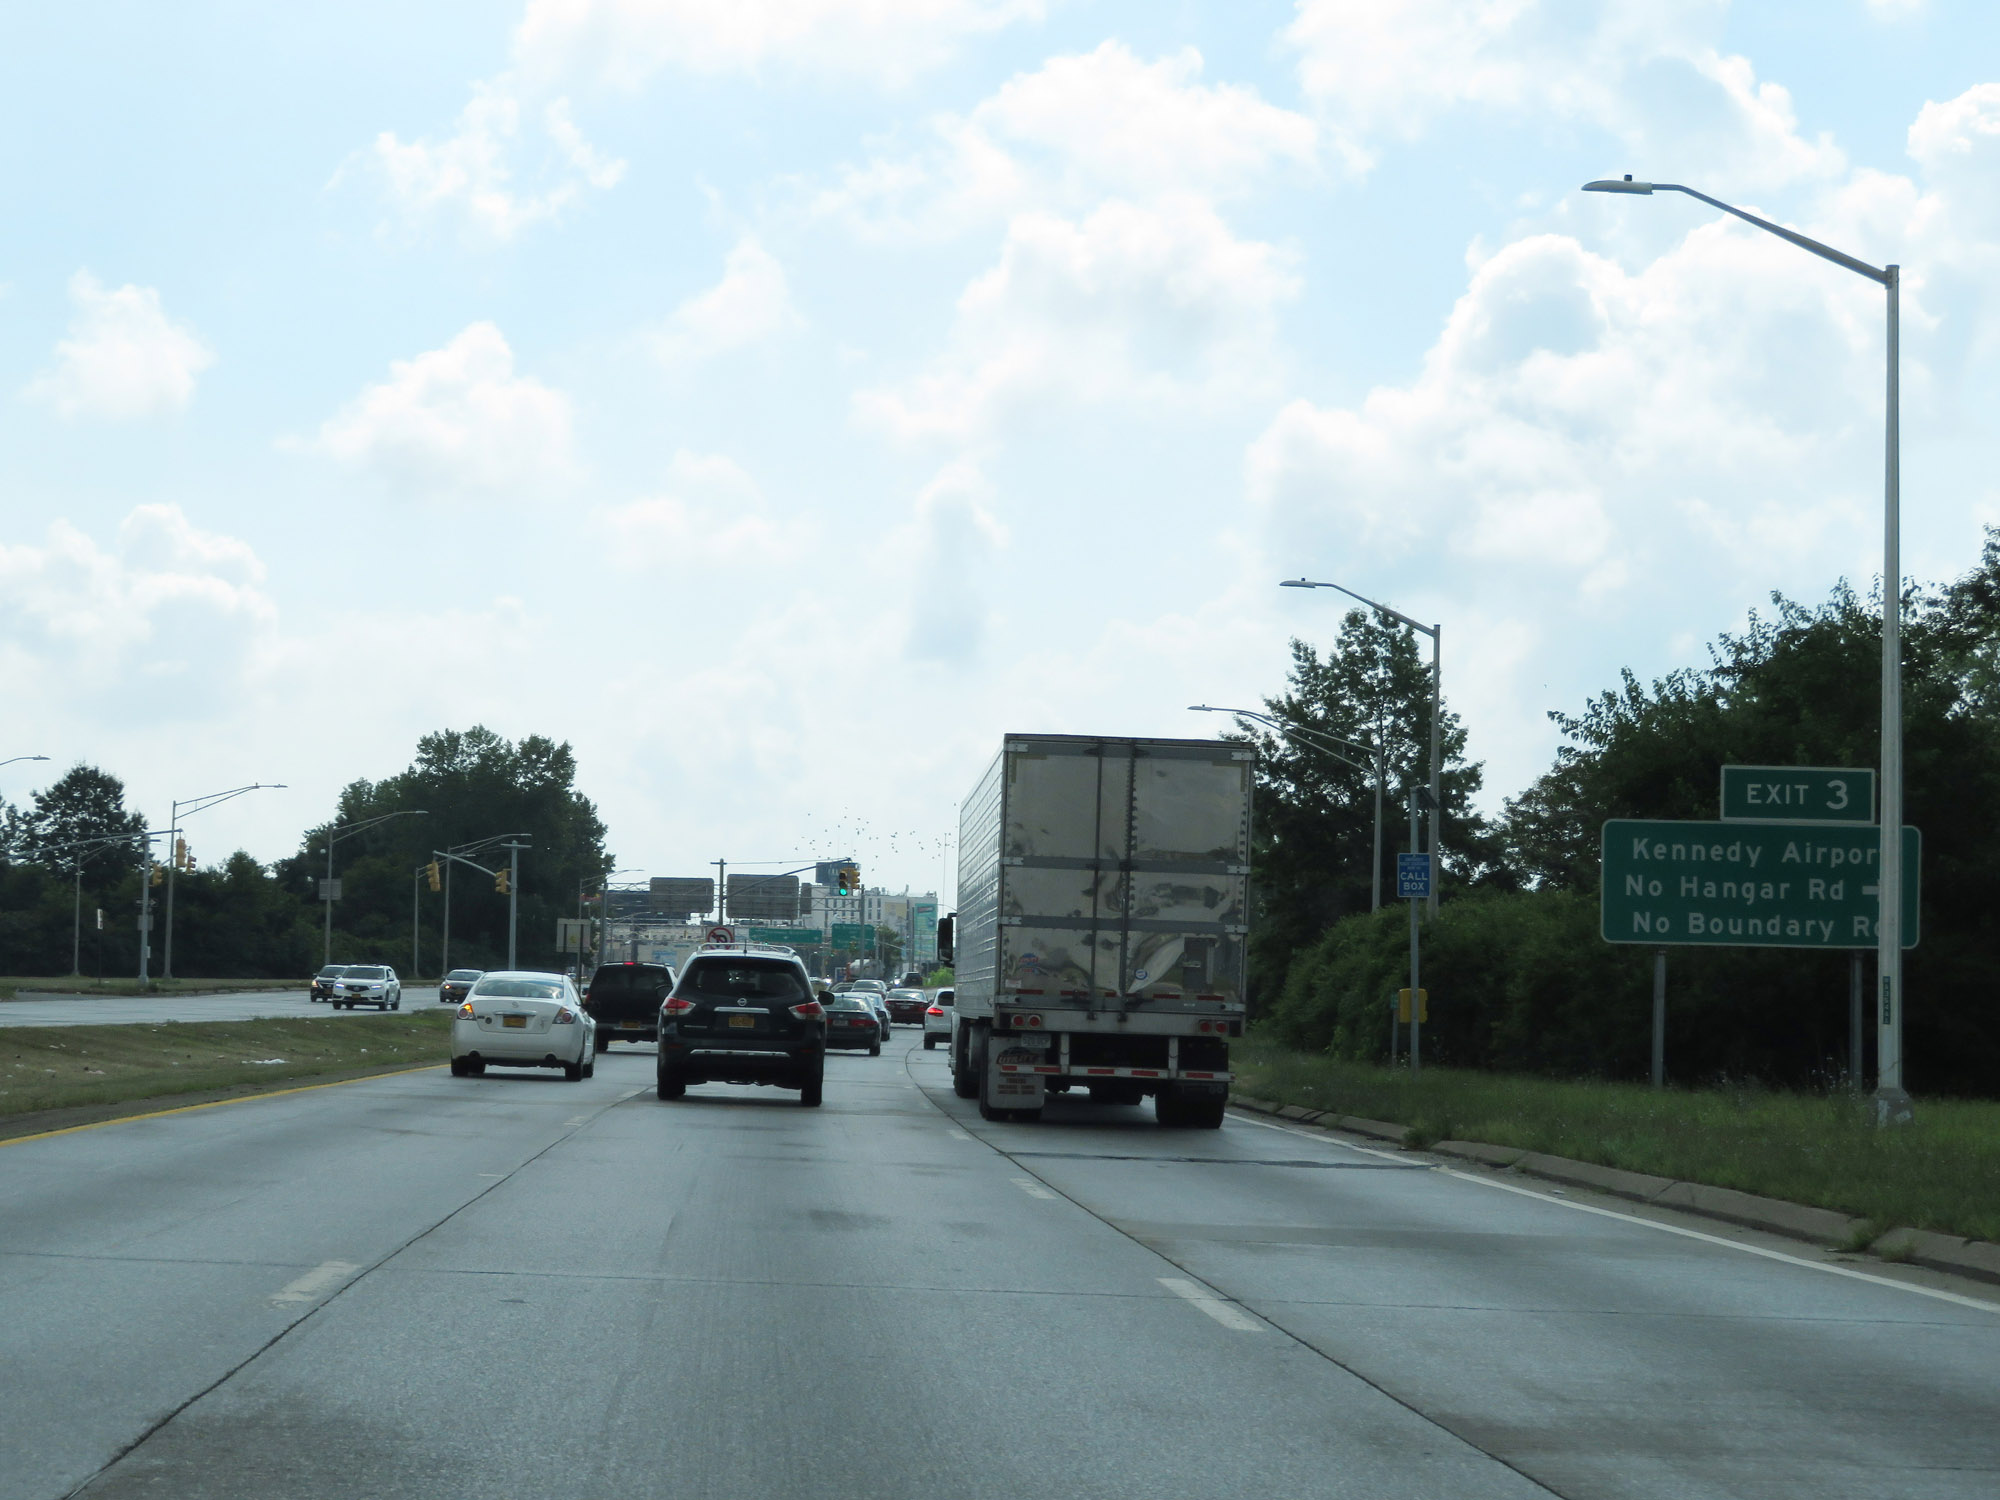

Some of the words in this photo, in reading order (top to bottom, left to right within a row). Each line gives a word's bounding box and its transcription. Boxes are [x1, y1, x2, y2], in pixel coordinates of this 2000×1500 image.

[1746, 783, 1809, 805] EXIT
[1826, 780, 1849, 810] 3
[1632, 837, 1762, 868] Kennedy
[1781, 841, 1880, 868] Airpor
[1400, 872, 1428, 881] CALL
[1403, 882, 1425, 891] BOX
[1625, 874, 1663, 897] No
[1680, 875, 1791, 905] Hangar
[1808, 878, 1844, 901] Rd
[1633, 911, 1670, 934] No
[1688, 911, 1835, 942] Boundary
